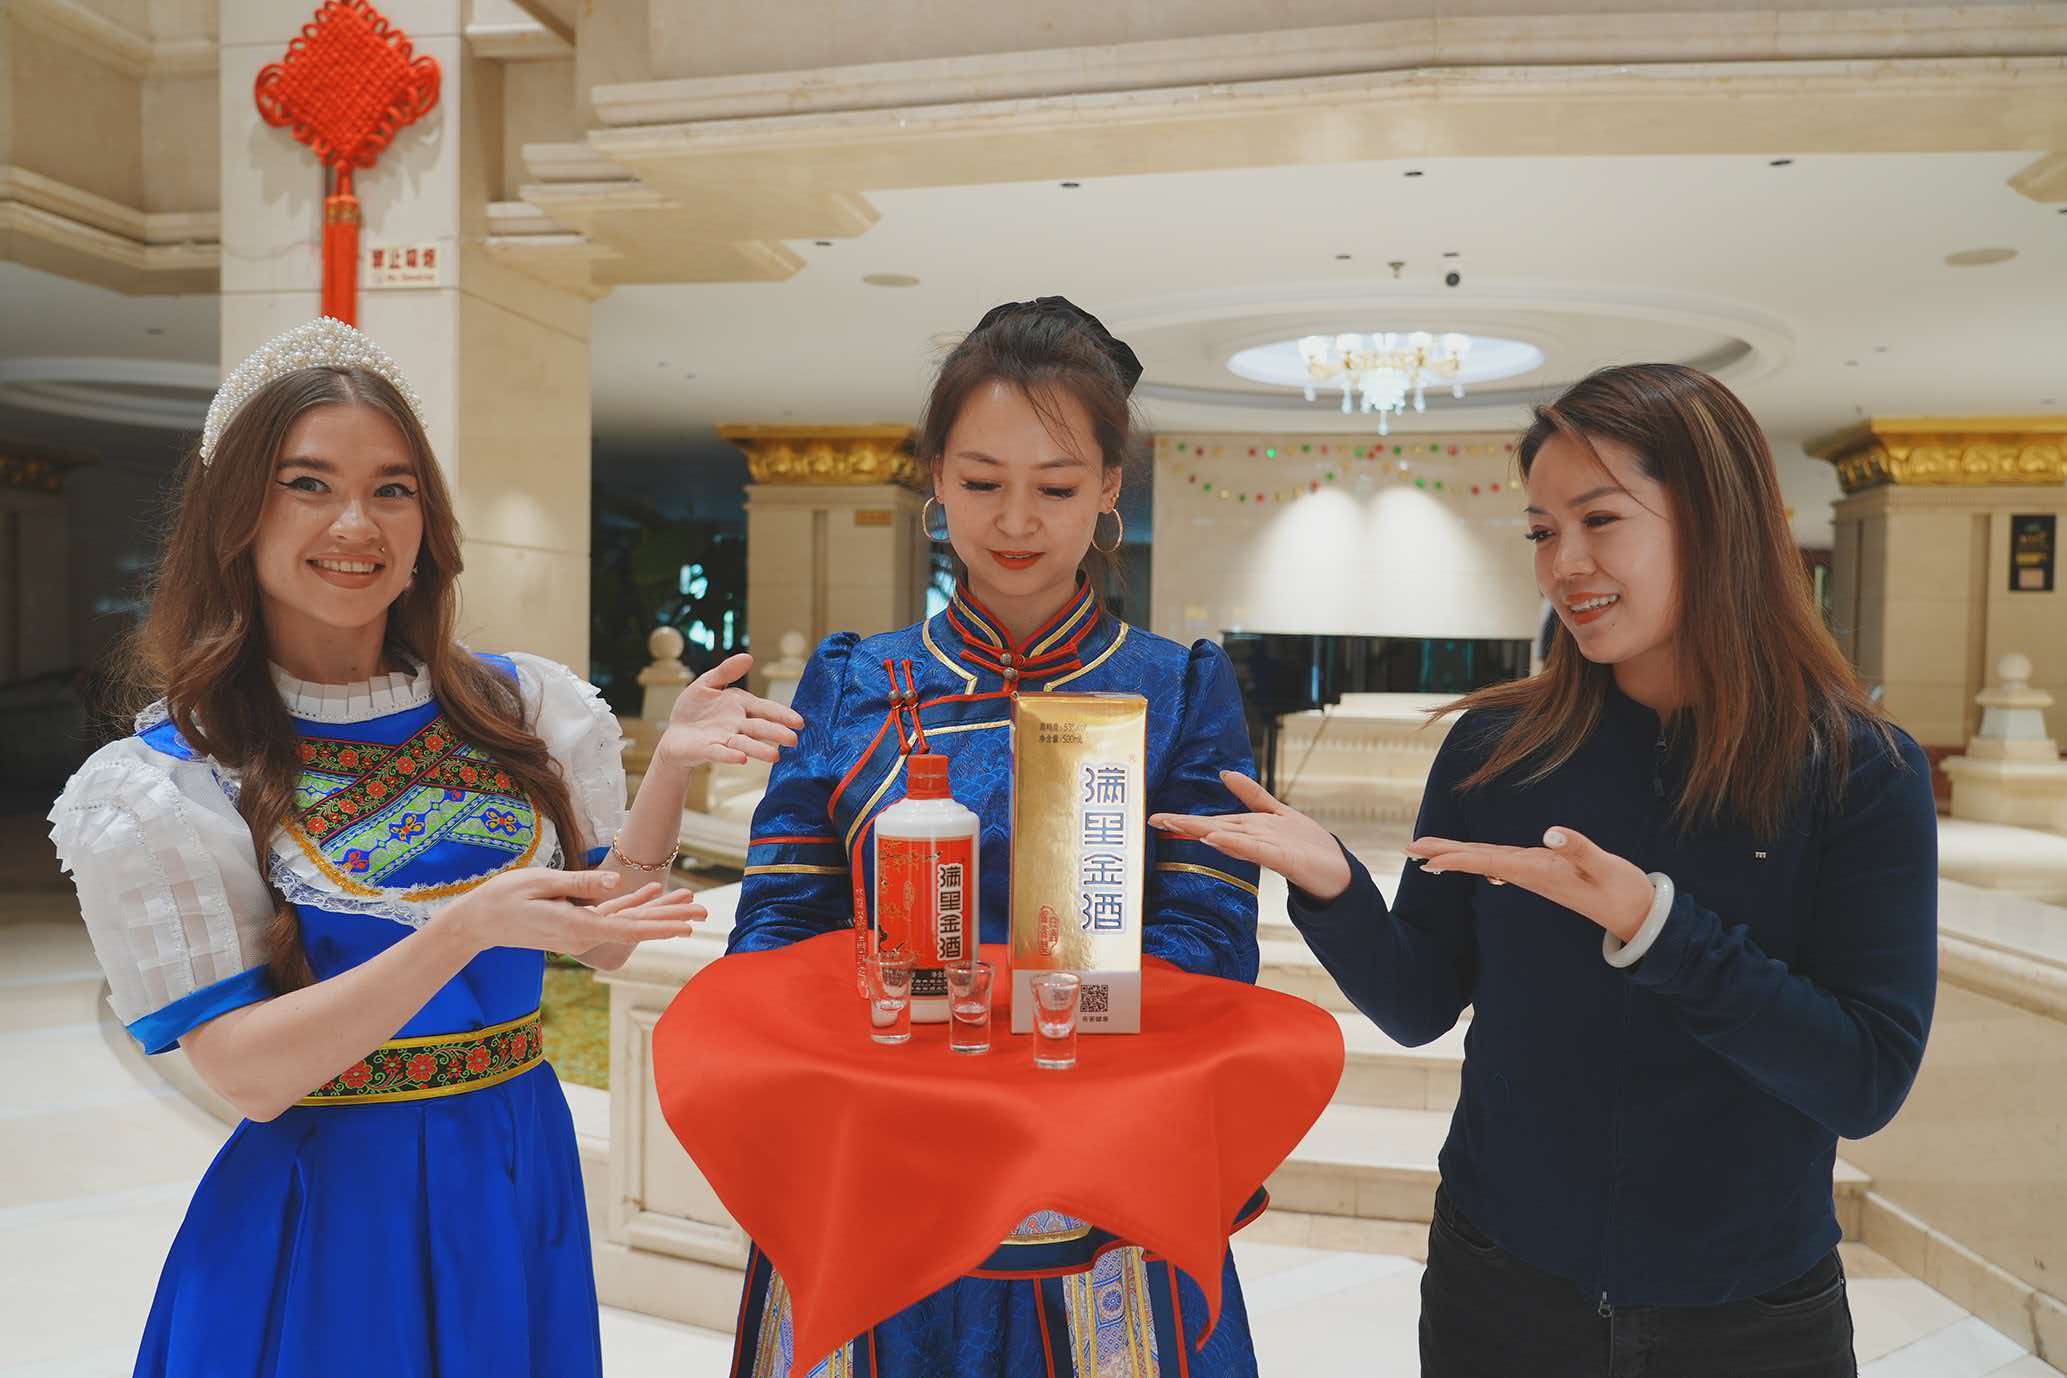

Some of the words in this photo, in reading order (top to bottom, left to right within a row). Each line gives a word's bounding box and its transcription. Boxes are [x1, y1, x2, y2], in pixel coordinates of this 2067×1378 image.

[939, 865, 961, 959] 满里金酒
[1082, 767, 1126, 930] 满里金酒
